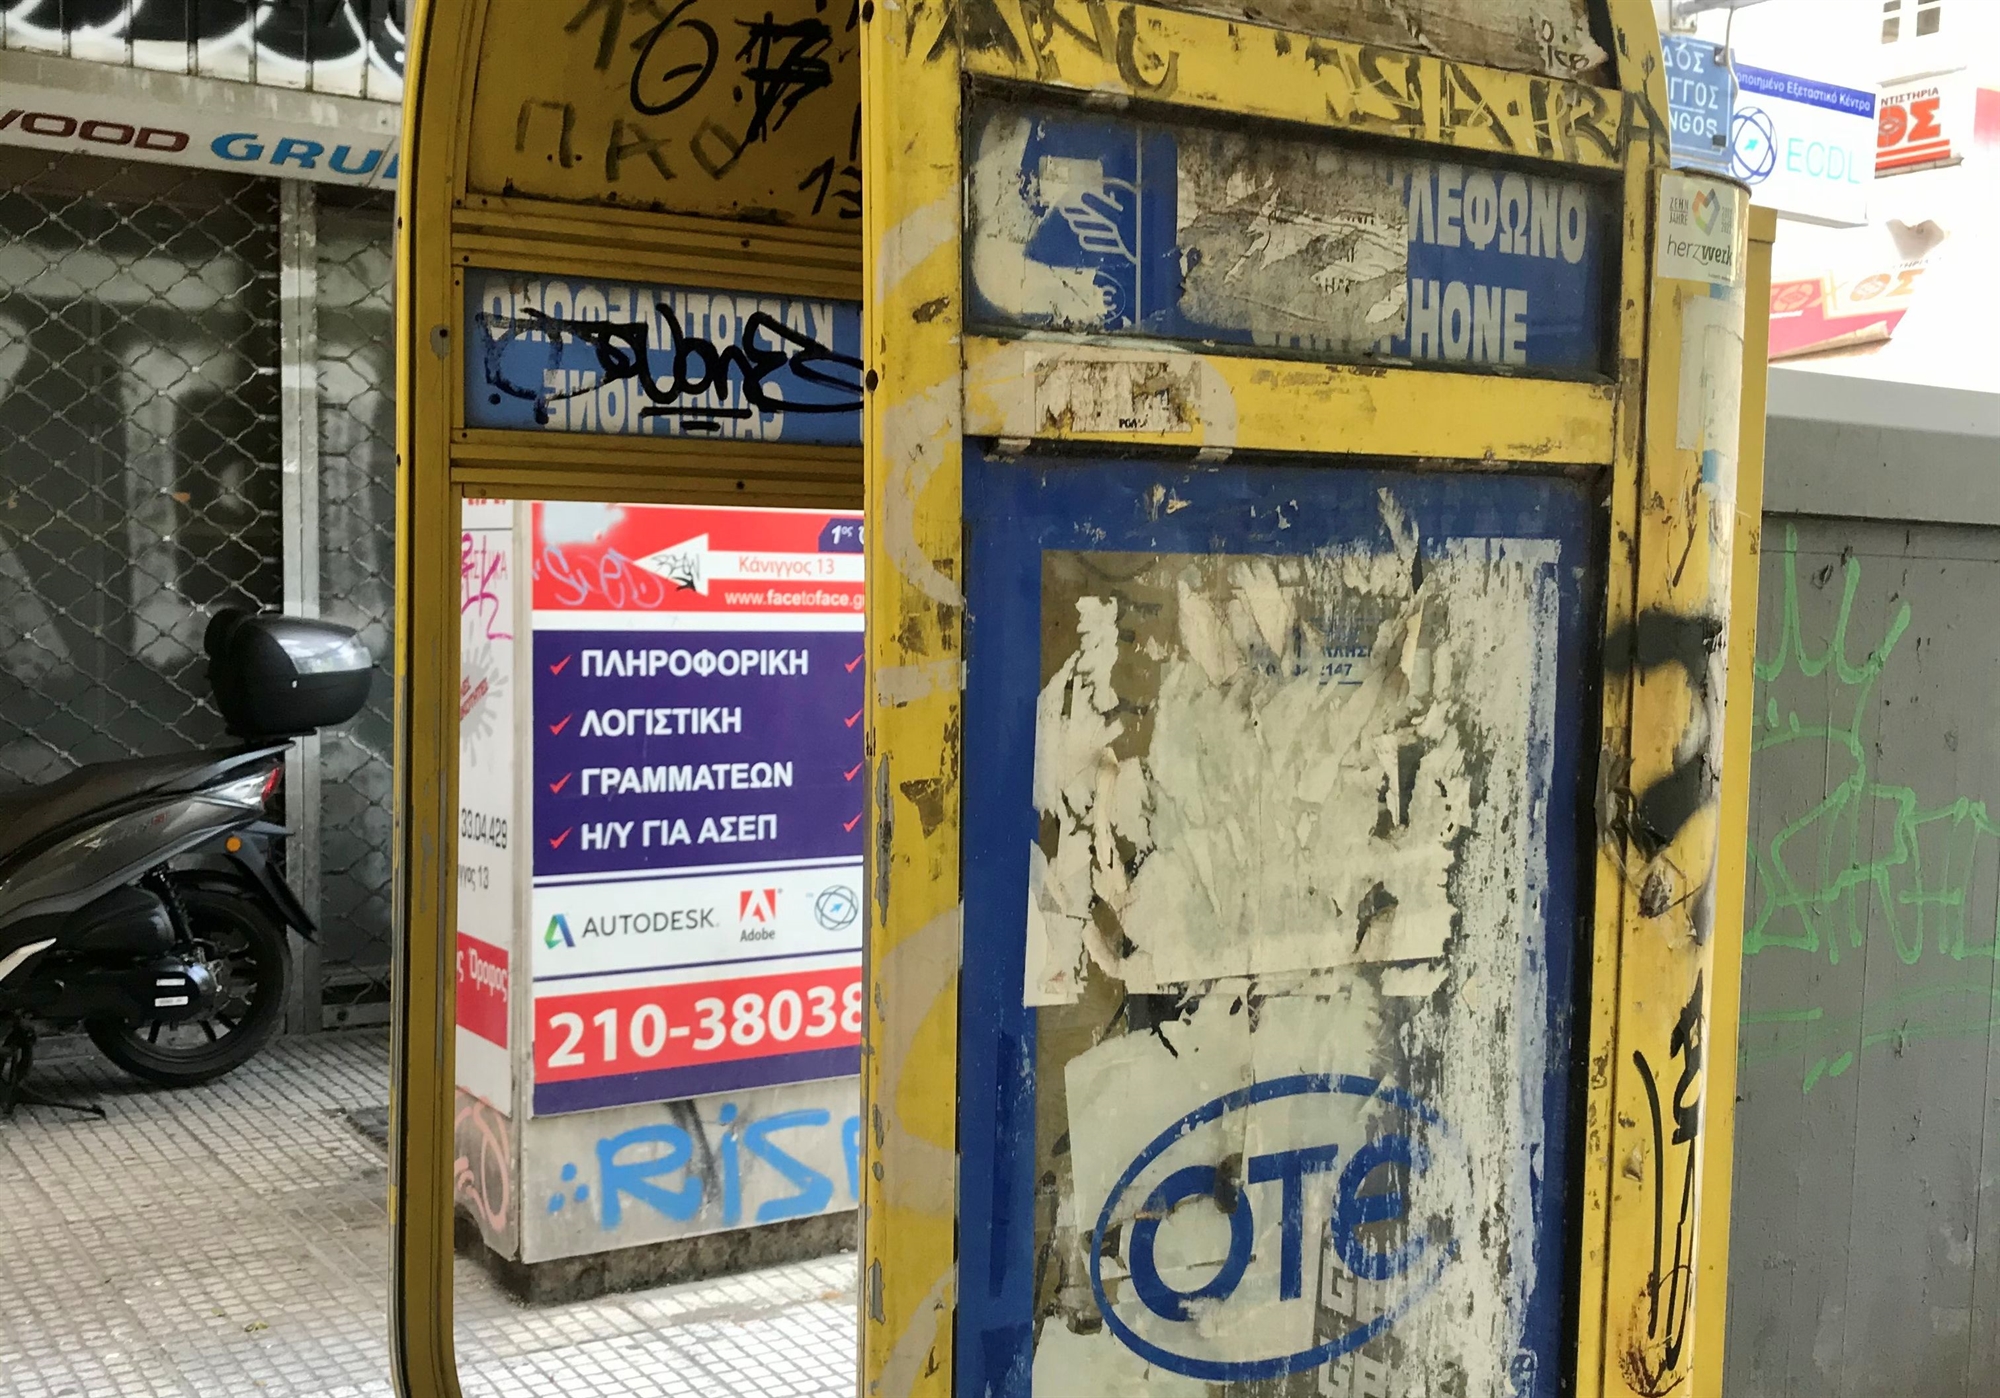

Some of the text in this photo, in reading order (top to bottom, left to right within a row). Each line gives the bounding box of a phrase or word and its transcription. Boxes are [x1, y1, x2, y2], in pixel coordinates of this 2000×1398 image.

[1667, 76, 1719, 111] ΓΓΟΣ
[1736, 72, 1871, 112] οποιημένο Εξεταστικό Κέντρο
[1881, 87, 1940, 107] ΝΤΙΣΤΗΡΙΑ
[1785, 137, 1861, 184] ECDL
[1669, 197, 1689, 210] ZEHN
[1669, 212, 1688, 226] JAHRE
[738, 556, 835, 579] Κάνιγγος 13
[581, 648, 809, 678] ΠΛΗΡΟΦΟΡΙΚΗ
[580, 706, 743, 738] ΛΟΓΙΣΤΙΚΗ
[581, 761, 793, 796] ΓΡΑΜΜΑΤΕΩΝ
[581, 813, 777, 851] Η/Υ ΓΙΑ ΑΣΕΠ
[478, 864, 489, 890] 13
[582, 907, 776, 942] AUTODESK Adobe
[547, 984, 862, 1069] 210-38038
